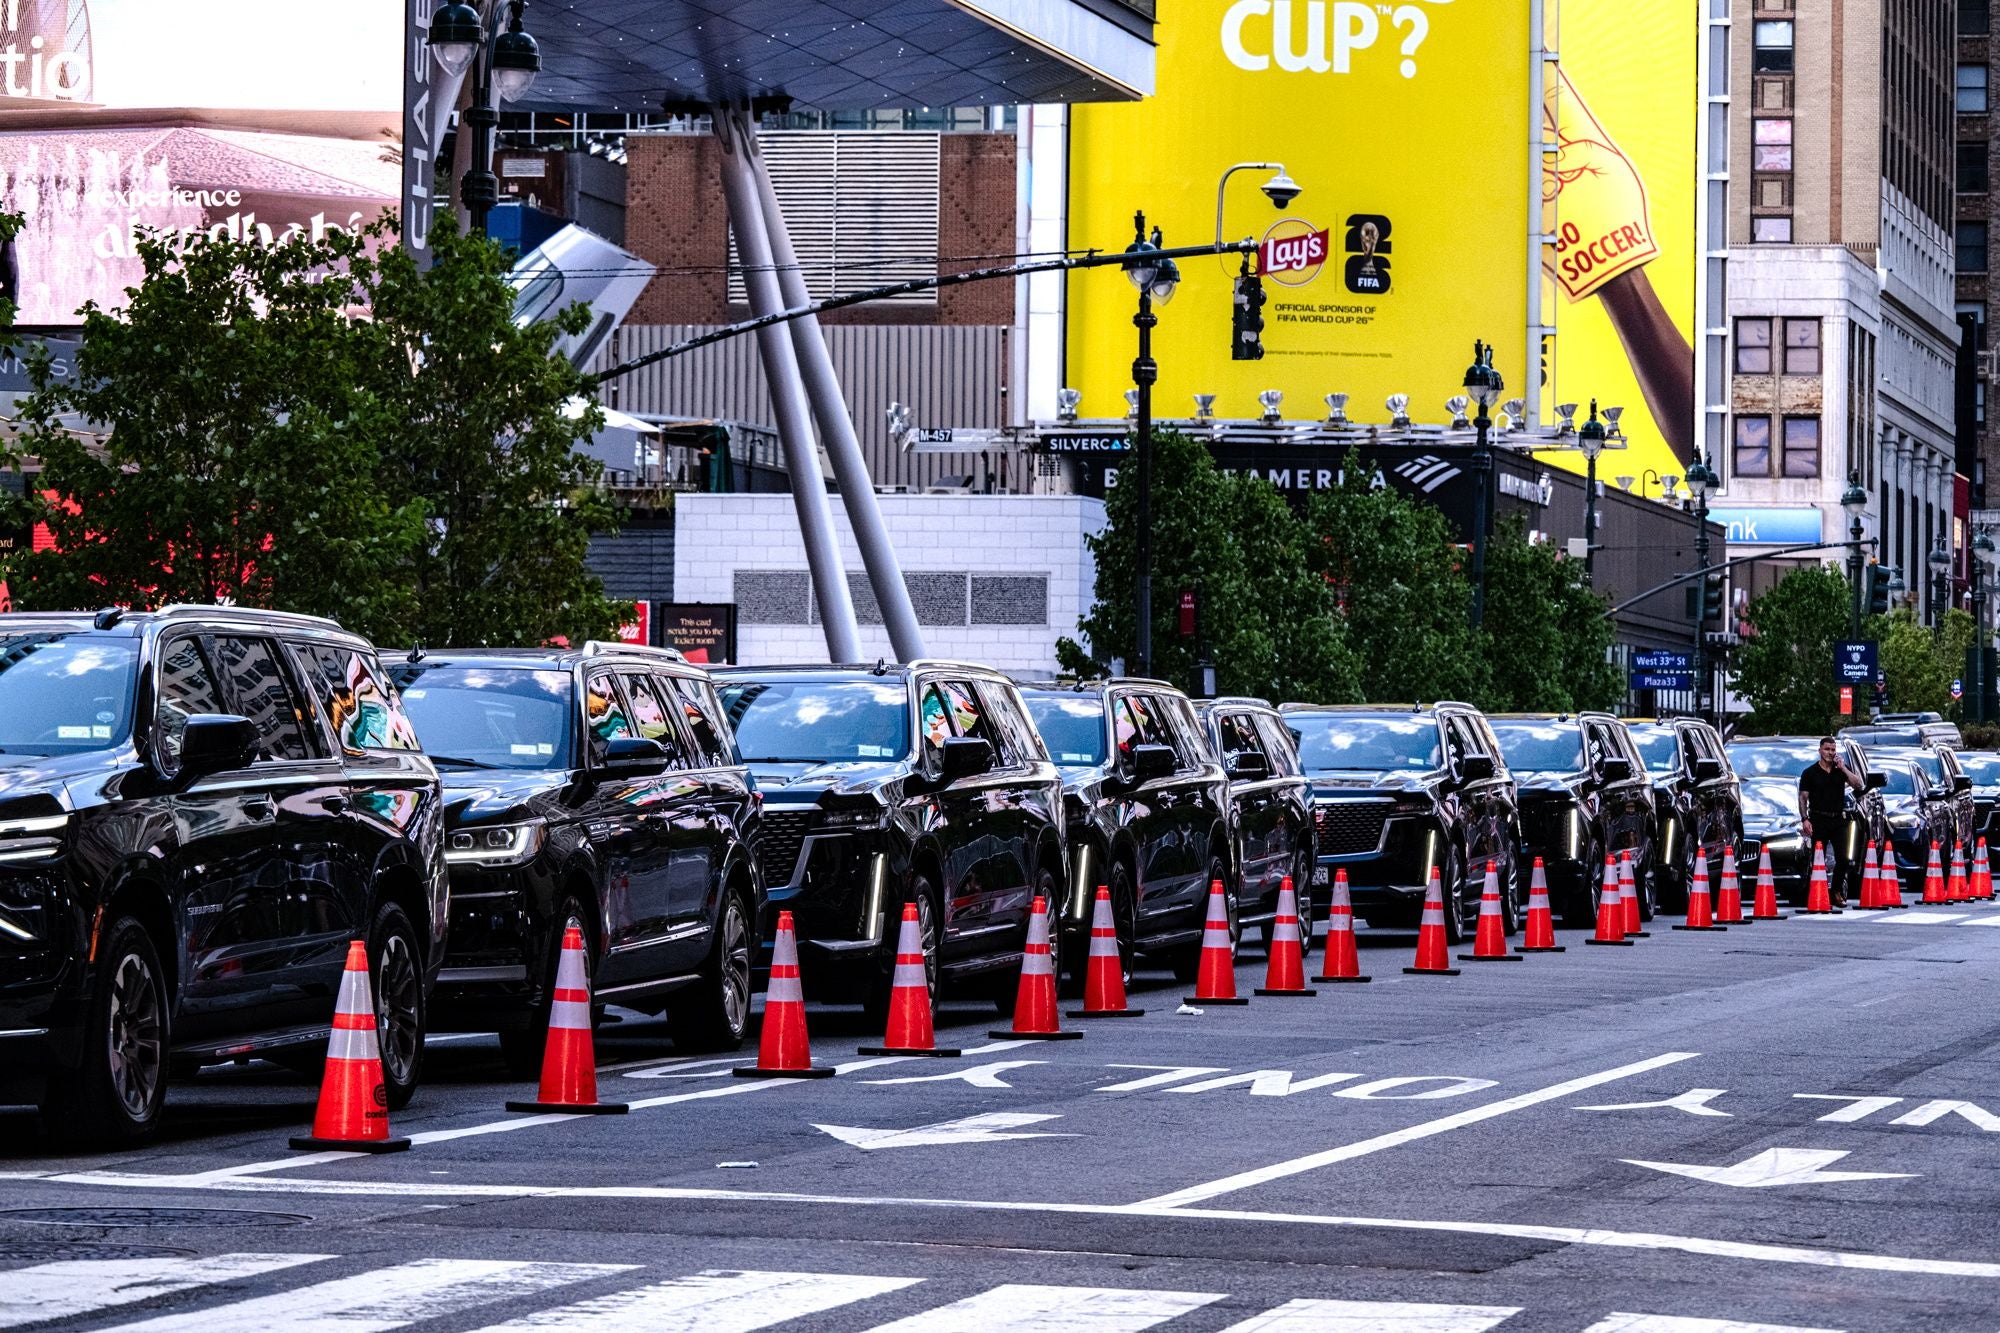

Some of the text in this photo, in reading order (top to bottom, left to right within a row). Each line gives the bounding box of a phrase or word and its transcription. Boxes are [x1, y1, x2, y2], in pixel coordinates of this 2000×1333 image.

[0, 35, 90, 97] tio
[411, 0, 432, 250] CHASE
[104, 185, 242, 210] experience
[1266, 232, 1325, 273] Lay's
[1561, 221, 1647, 282] SOCCER!
[1357, 277, 1380, 288] FIFA
[1274, 303, 1376, 314] OFFICIAL SPONSOR OF
[1277, 314, 1297, 322] FIFA
[1300, 315, 1334, 324] WORLD
[1335, 315, 1355, 324] CUP
[919, 430, 952, 442] M-457
[1050, 438, 1132, 450] SILVERCAS
[1250, 468, 1387, 490] AMERIA
[1846, 644, 1866, 652] NYPD
[1636, 656, 1686, 666] West 33rd St
[1843, 663, 1869, 671] Security
[1644, 676, 1677, 687] Plaza33
